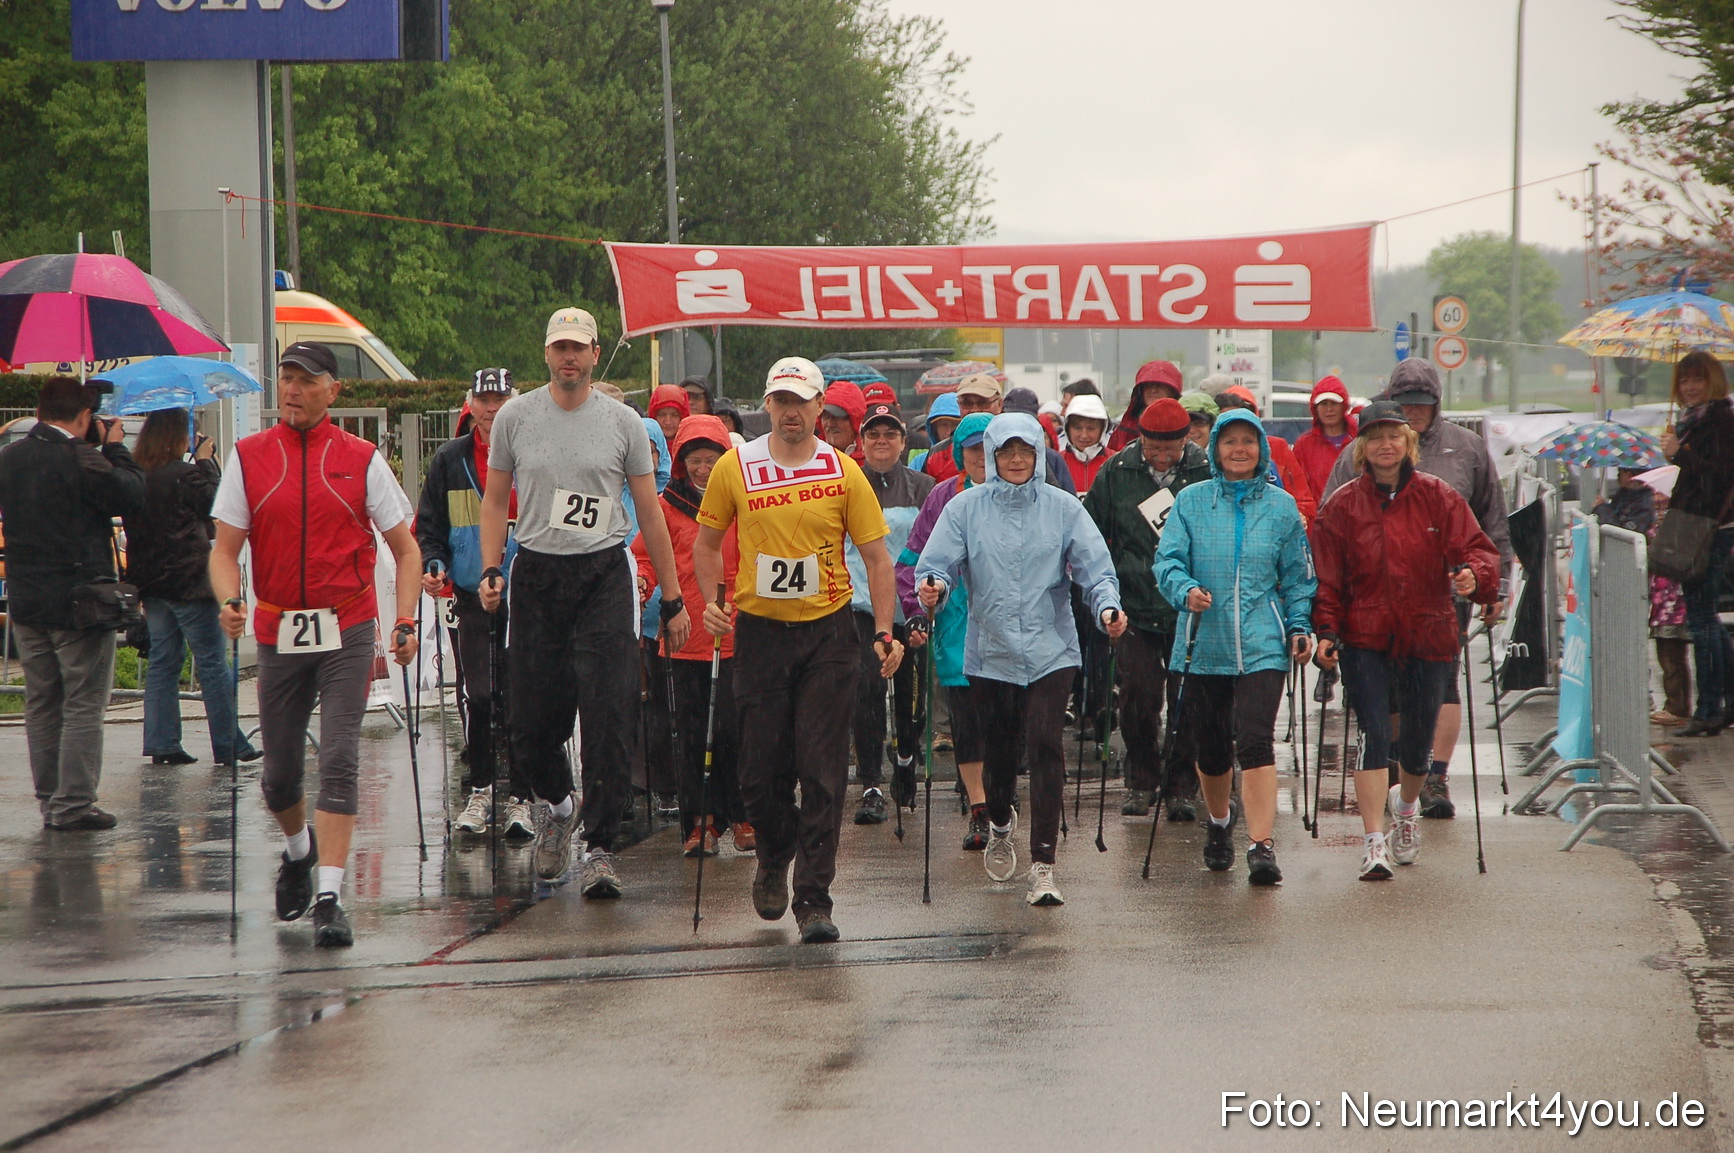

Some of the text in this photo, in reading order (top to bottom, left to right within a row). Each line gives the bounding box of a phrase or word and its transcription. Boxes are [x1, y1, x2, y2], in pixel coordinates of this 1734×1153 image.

[1442, 307, 1461, 323] 60
[564, 493, 598, 527] 25
[748, 484, 846, 512] MAX BÖGL
[771, 559, 807, 593] 24
[292, 612, 324, 647] 21
